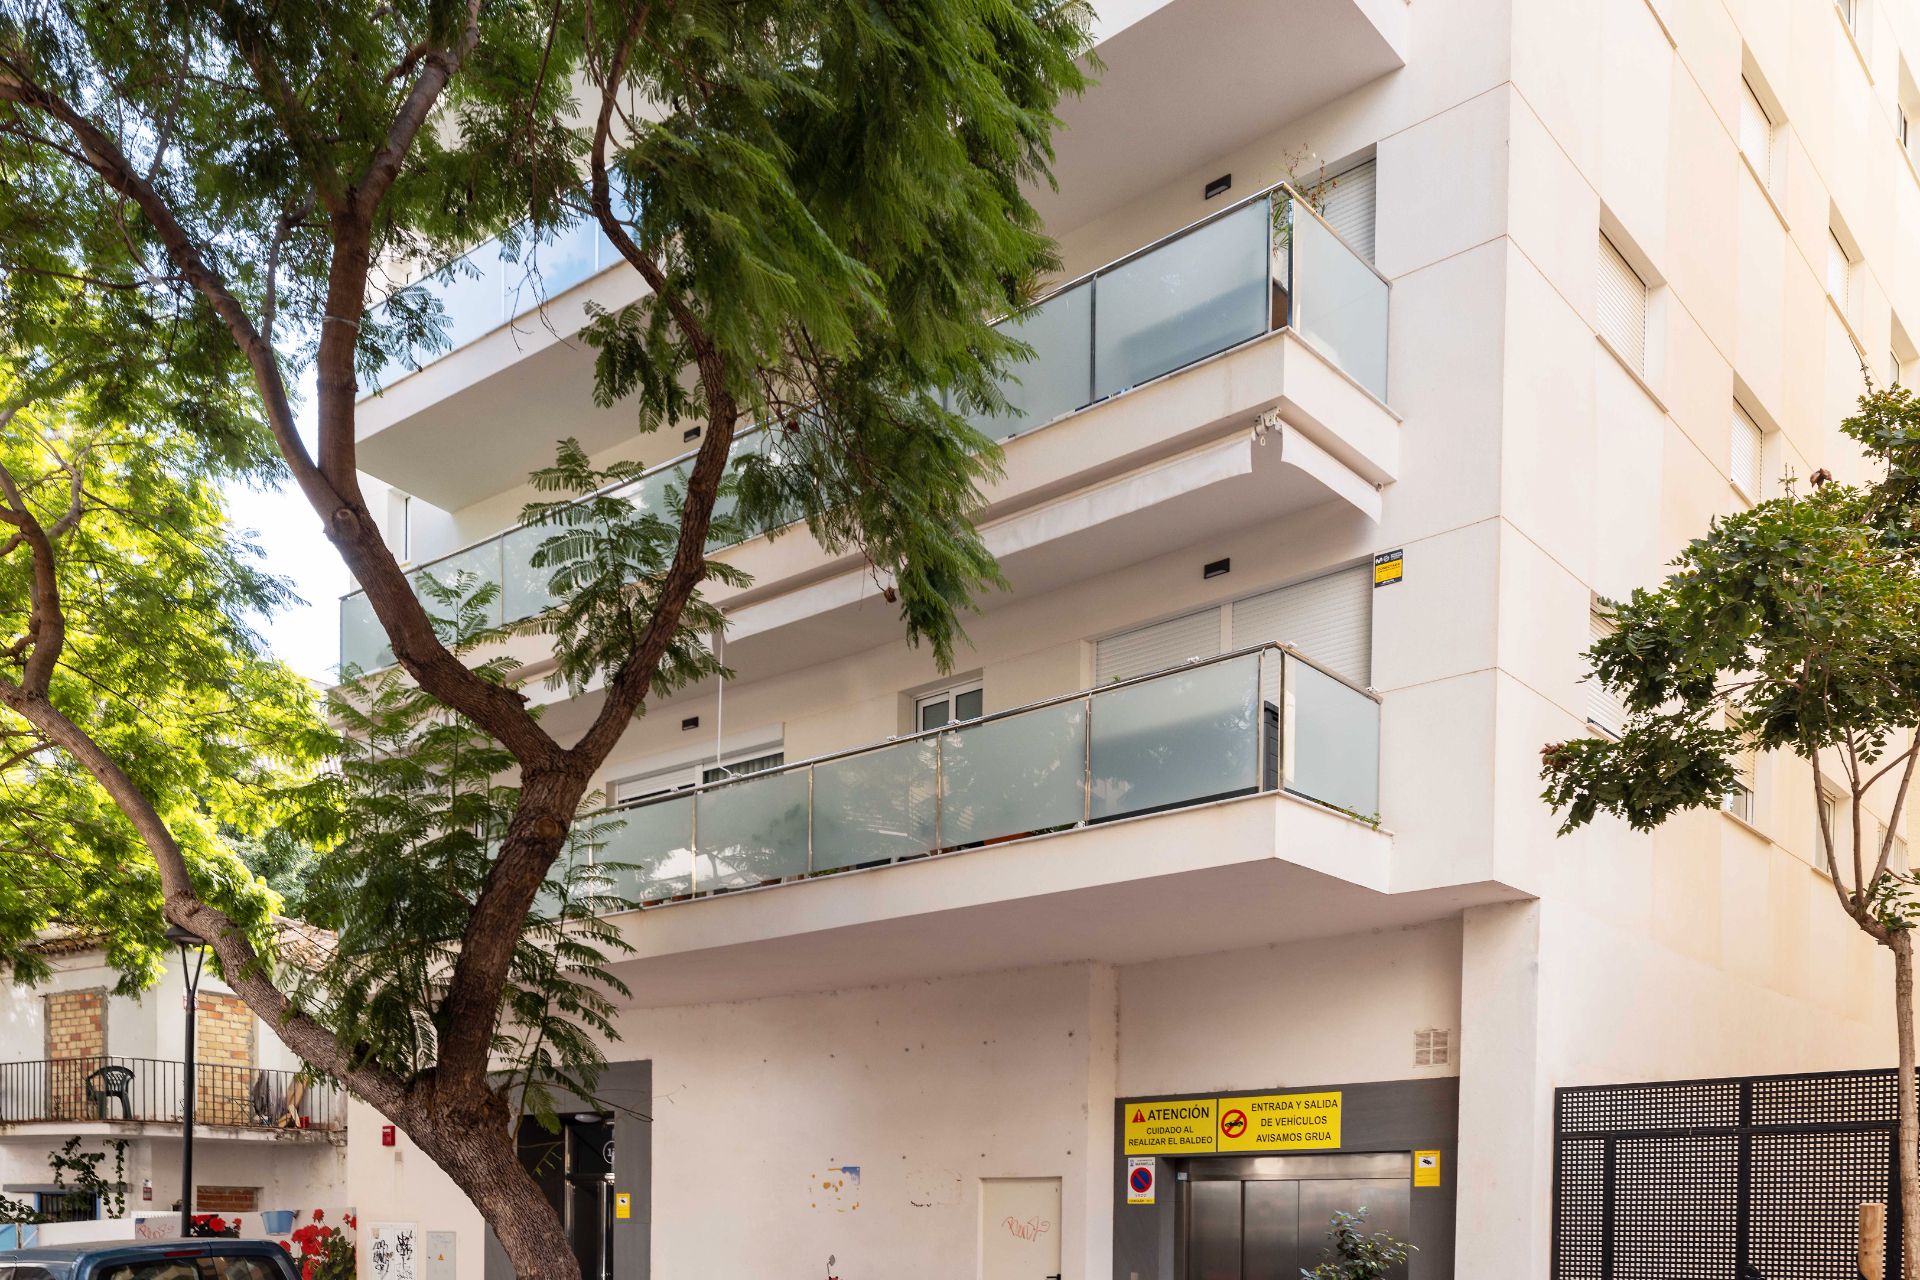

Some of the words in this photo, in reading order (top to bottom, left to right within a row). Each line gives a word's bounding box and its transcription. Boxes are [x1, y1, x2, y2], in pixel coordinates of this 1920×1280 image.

[1251, 1101, 1294, 1112] ENTRADA
[1296, 1101, 1302, 1110] Y
[1304, 1099, 1338, 1110] SALIDA
[1147, 1104, 1210, 1121] ATENCIÓN
[1261, 1118, 1273, 1127] DE
[1275, 1115, 1328, 1126] VEHÍCULOS
[1146, 1126, 1182, 1135] CUIDADO
[1128, 1138, 1166, 1146] REALIZAR
[1168, 1137, 1178, 1145] EL
[1180, 1136, 1213, 1145] BALDEO
[1256, 1133, 1302, 1142] AVISAMOS
[1304, 1132, 1332, 1141] GRUA
